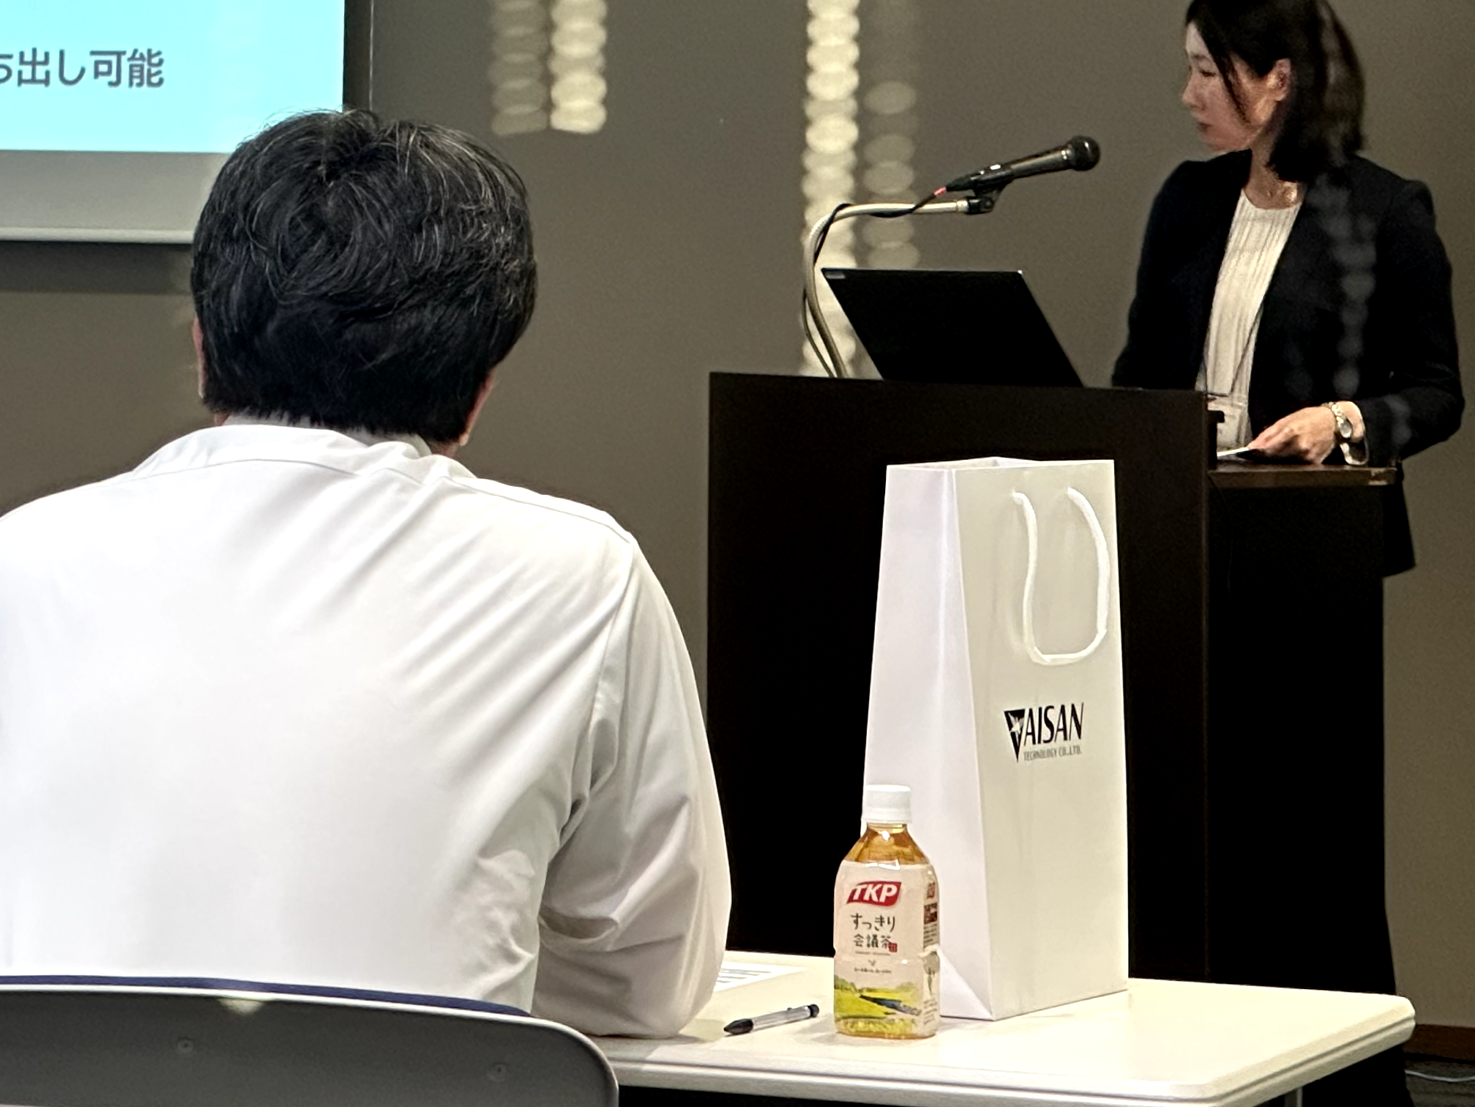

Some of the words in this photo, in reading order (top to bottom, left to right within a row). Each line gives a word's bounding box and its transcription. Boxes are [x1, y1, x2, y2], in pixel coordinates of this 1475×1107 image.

[1024, 702, 1084, 746] AISAN
[852, 883, 898, 903] TKP
[850, 912, 896, 933] すっきり
